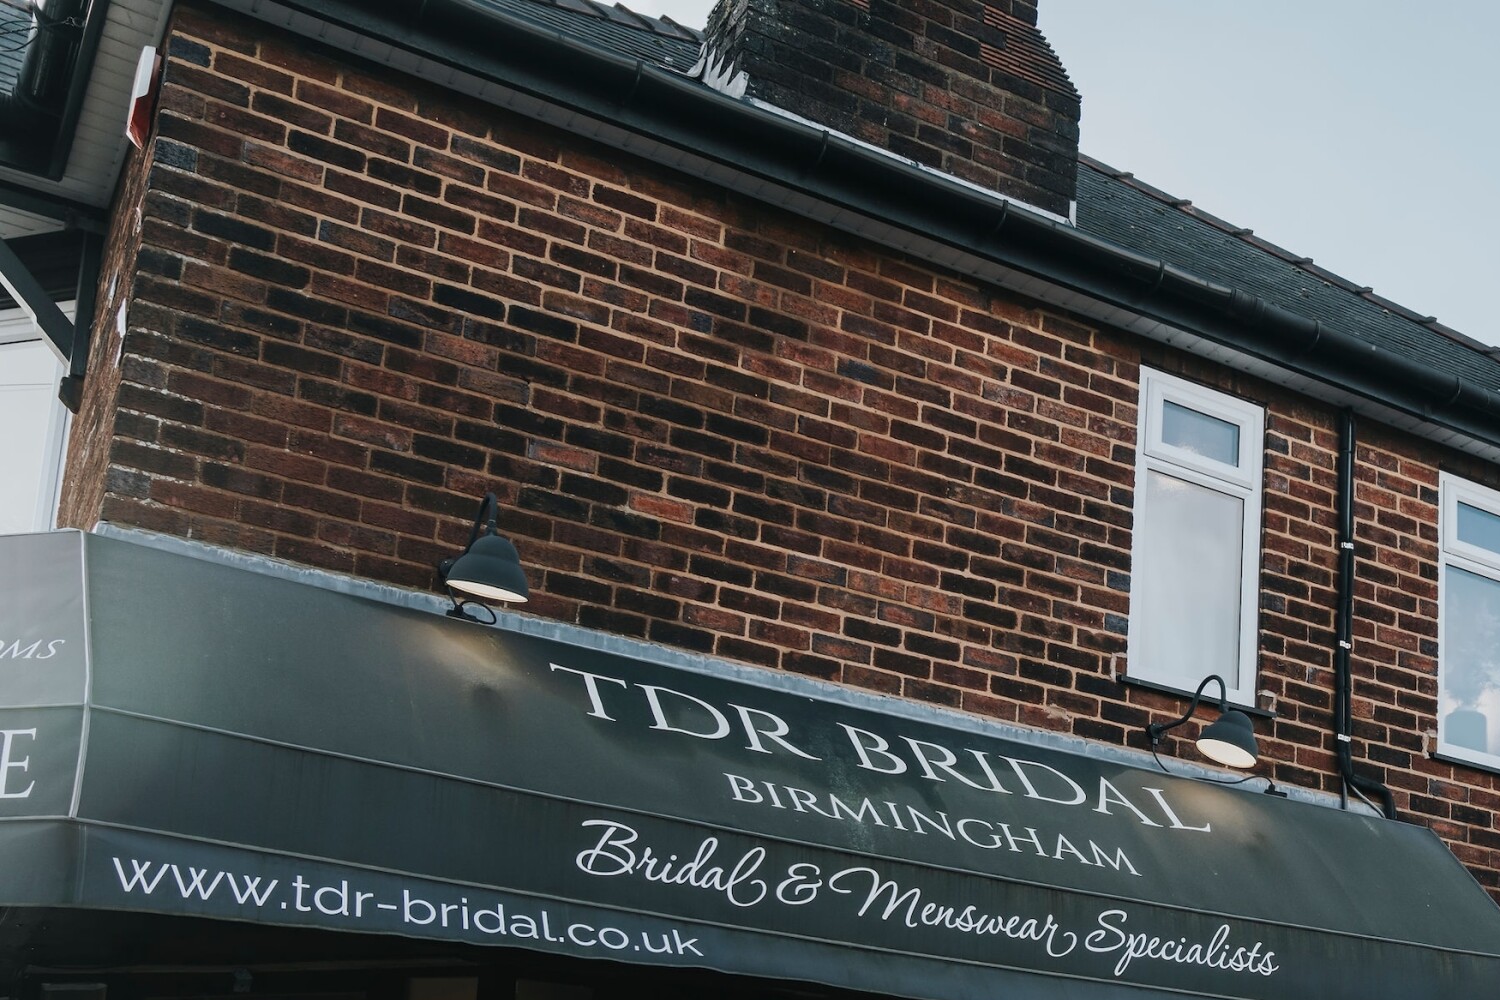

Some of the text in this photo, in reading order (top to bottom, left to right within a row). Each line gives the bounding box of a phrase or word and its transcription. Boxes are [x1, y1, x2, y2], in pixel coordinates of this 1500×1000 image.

[550, 662, 1212, 833] TDR BRIDAL
[723, 772, 1142, 877] BIRMINGHAM
[112, 856, 704, 957] www.tdr-bridal.co.uk
[575, 820, 1280, 977] Bridal & Menswear Specialists
